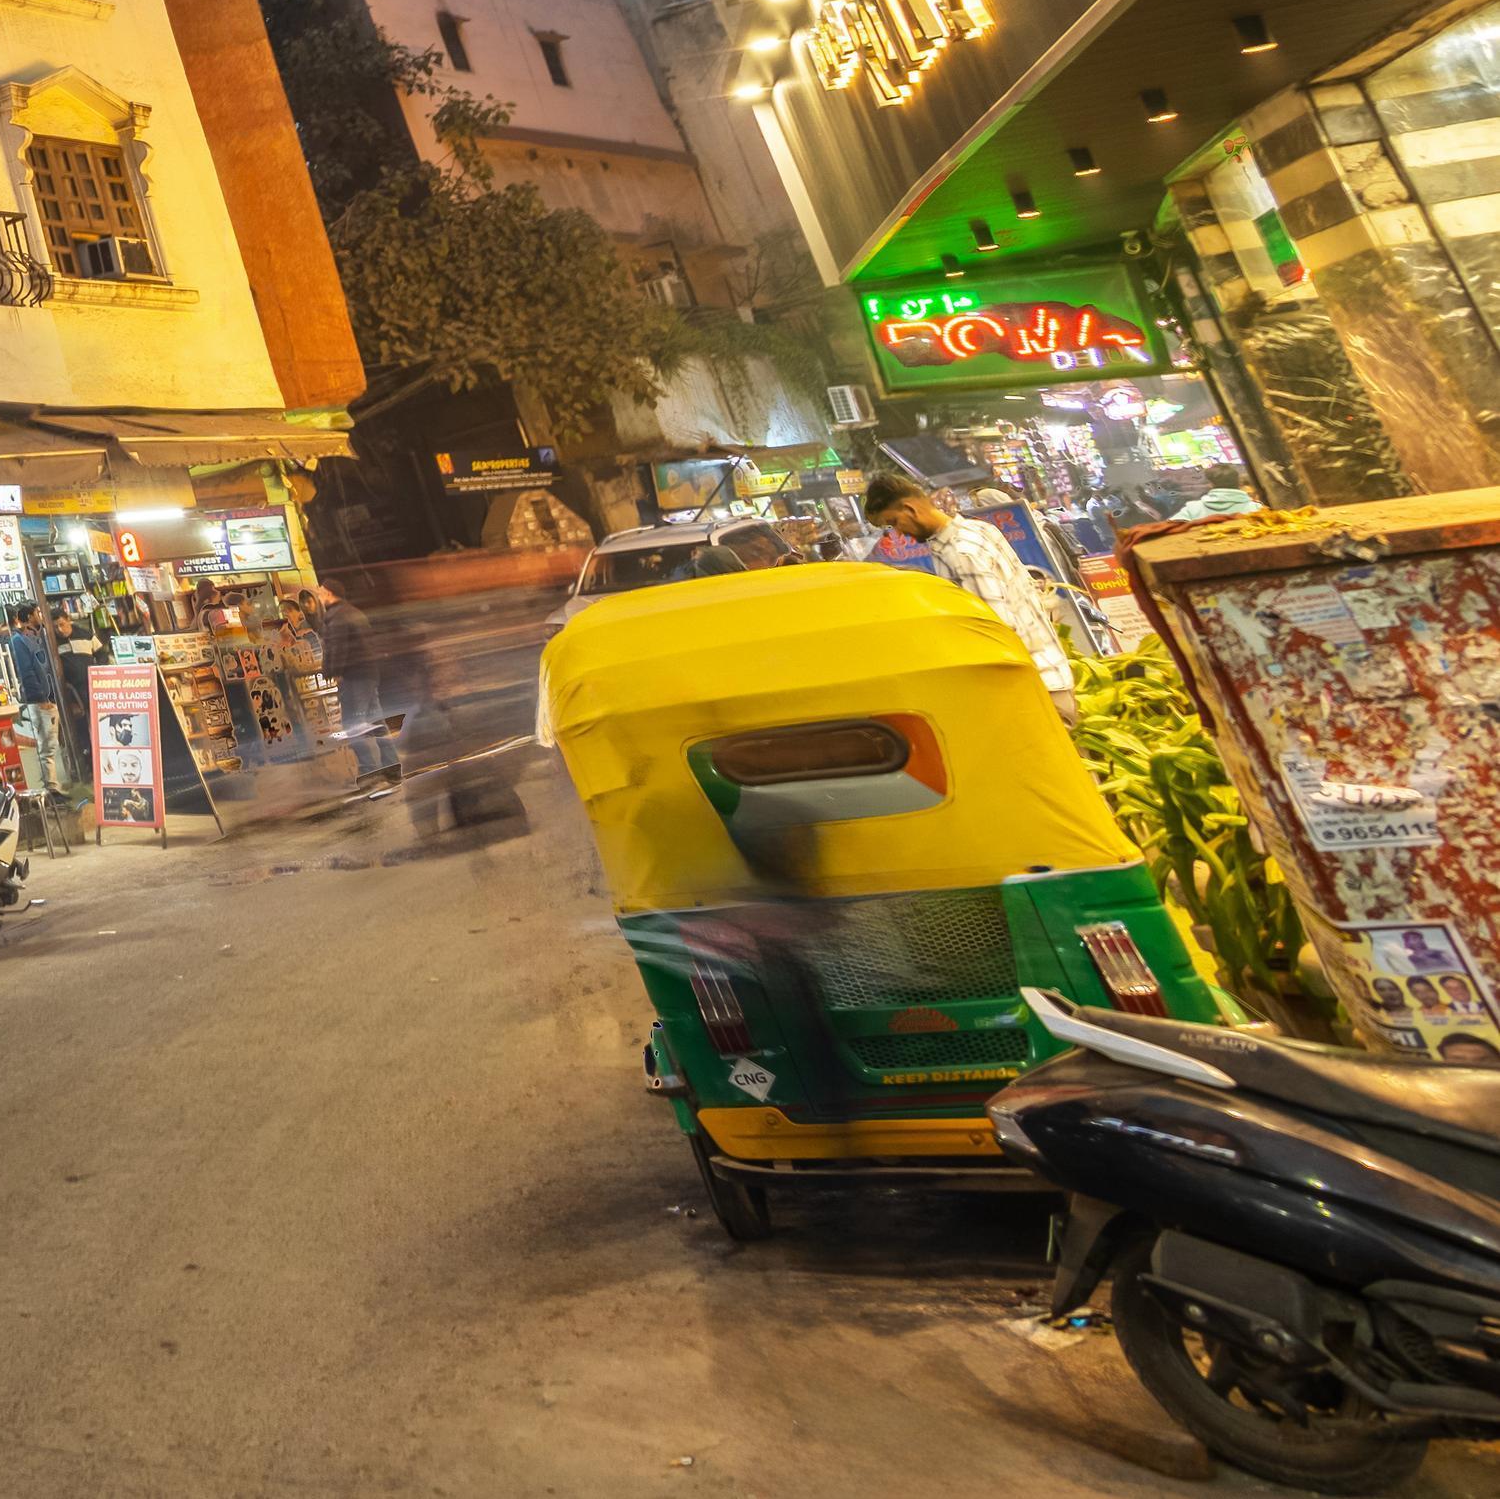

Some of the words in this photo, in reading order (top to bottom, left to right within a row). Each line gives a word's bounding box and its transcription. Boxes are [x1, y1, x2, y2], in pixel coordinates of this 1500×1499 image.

[184, 556, 221, 565] CHEPEST
[194, 563, 230, 572] TICKETS
[1091, 575, 1129, 591] COMMU
[122, 678, 151, 688] SALOON
[93, 692, 118, 700] GENTS
[125, 691, 152, 699] LADIES
[97, 701, 115, 709] HAIR
[116, 701, 149, 709] CUTTING
[734, 1071, 768, 1087] CNG
[881, 1073, 931, 1085] KEEP
